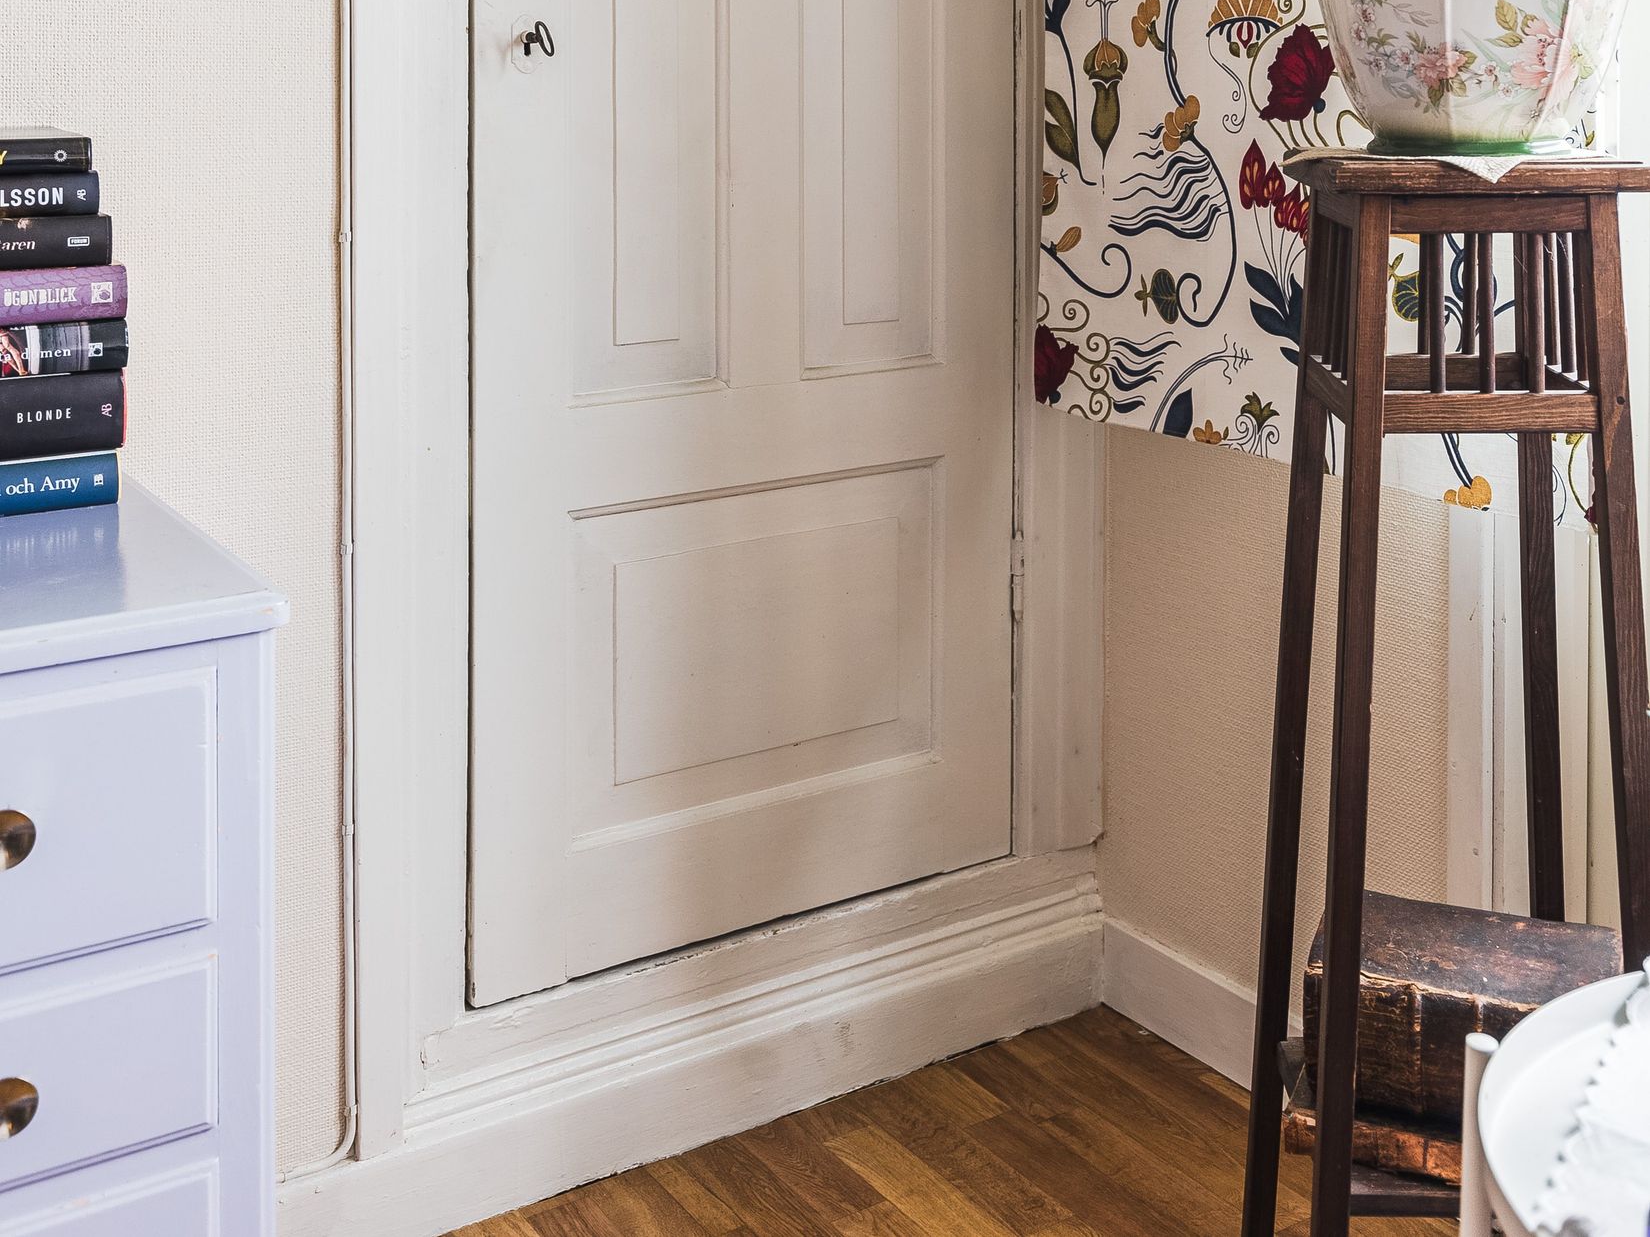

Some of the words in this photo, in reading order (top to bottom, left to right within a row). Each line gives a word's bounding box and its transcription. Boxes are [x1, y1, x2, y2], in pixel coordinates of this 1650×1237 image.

[0, 240, 36, 251] aren
[4, 287, 77, 307] ÖGONBLICK
[16, 408, 72, 424] BLONDE
[5, 477, 35, 496] och
[40, 475, 80, 493] Amy
